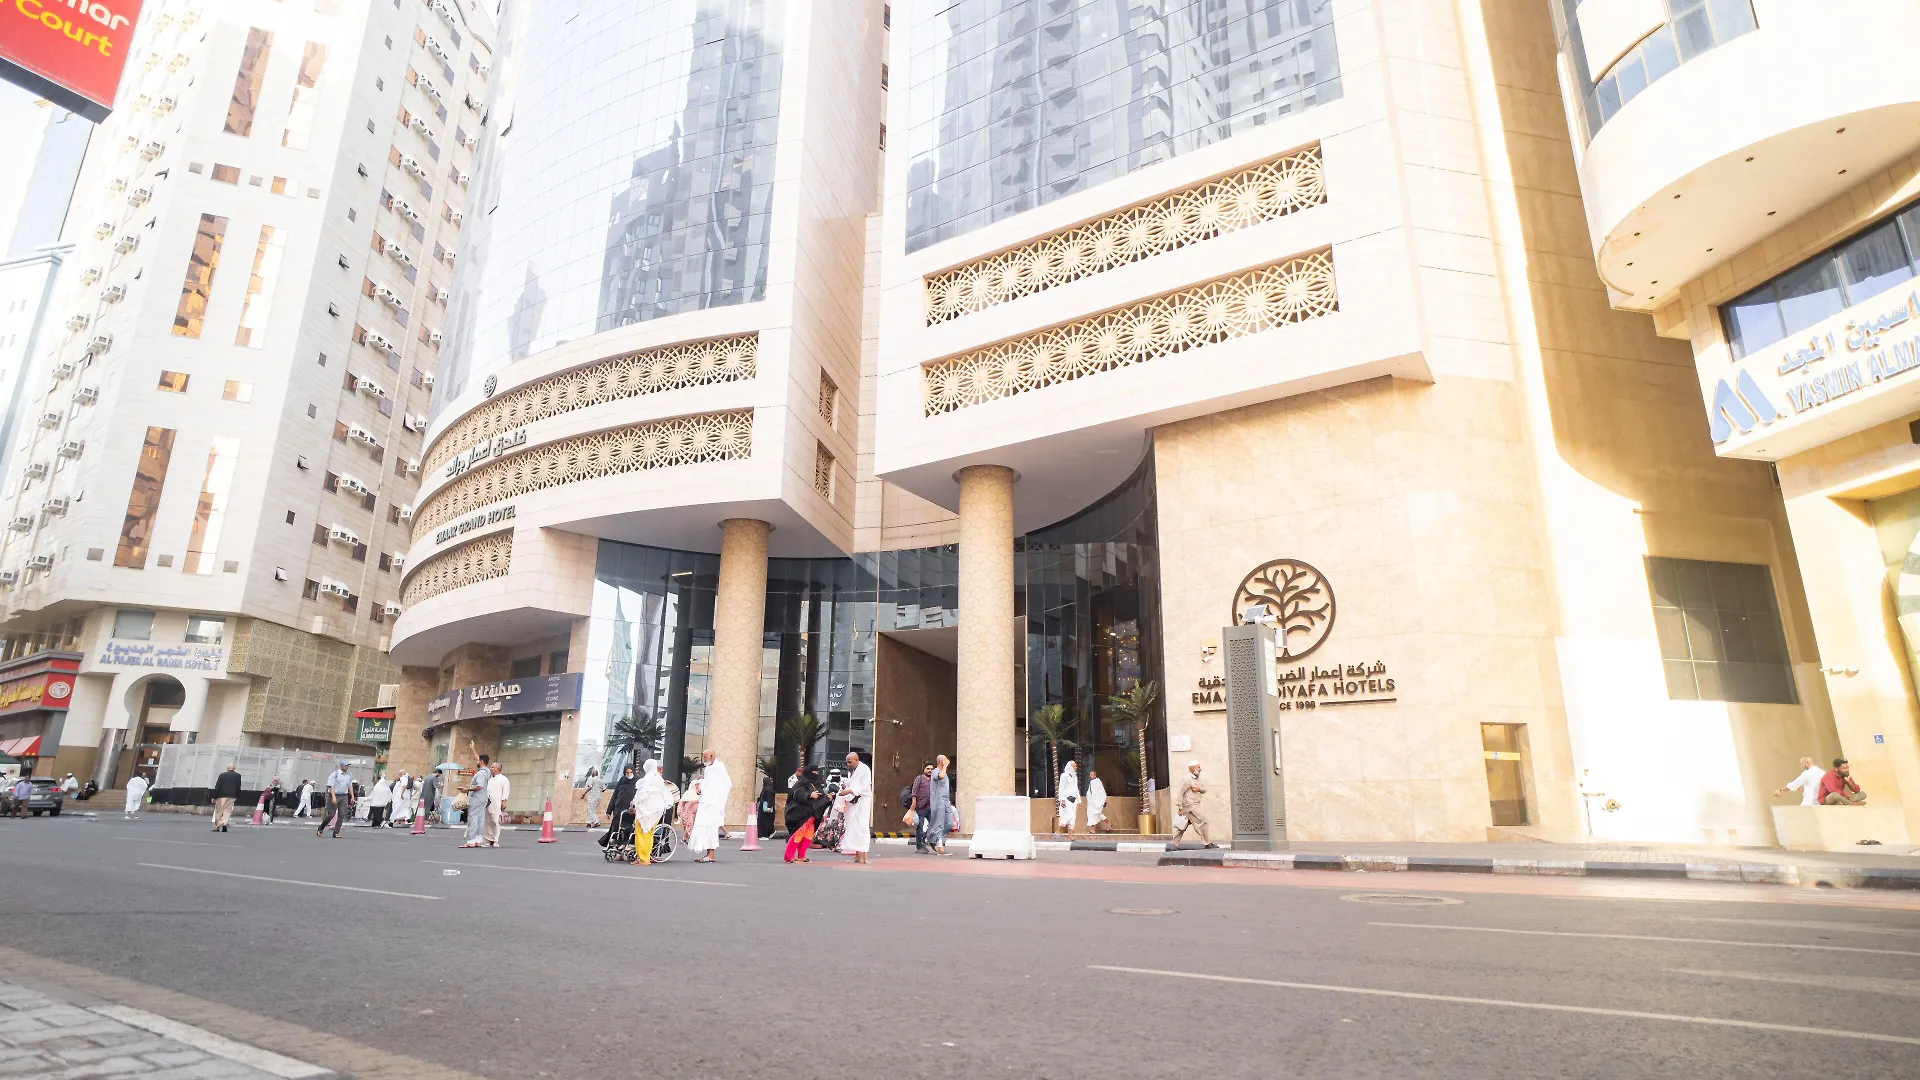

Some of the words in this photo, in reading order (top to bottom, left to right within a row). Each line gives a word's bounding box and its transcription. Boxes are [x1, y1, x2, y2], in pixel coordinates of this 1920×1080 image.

[16, 0, 113, 57] Court
[1845, 290, 1920, 353] اسمين
[1777, 328, 1835, 376] المجد
[1787, 360, 1864, 414] YASMIN
[458, 514, 487, 535] GRAND
[488, 505, 516, 525] HOTEL
[100, 654, 112, 664] AL
[142, 657, 154, 667] AL
[1310, 663, 1343, 682] إعمار
[1346, 660, 1386, 678] شركة
[489, 682, 522, 701] صيدلية
[1191, 691, 1226, 704] EMA
[1334, 679, 1395, 695] HOTELS
[1296, 701, 1316, 710] 1998
